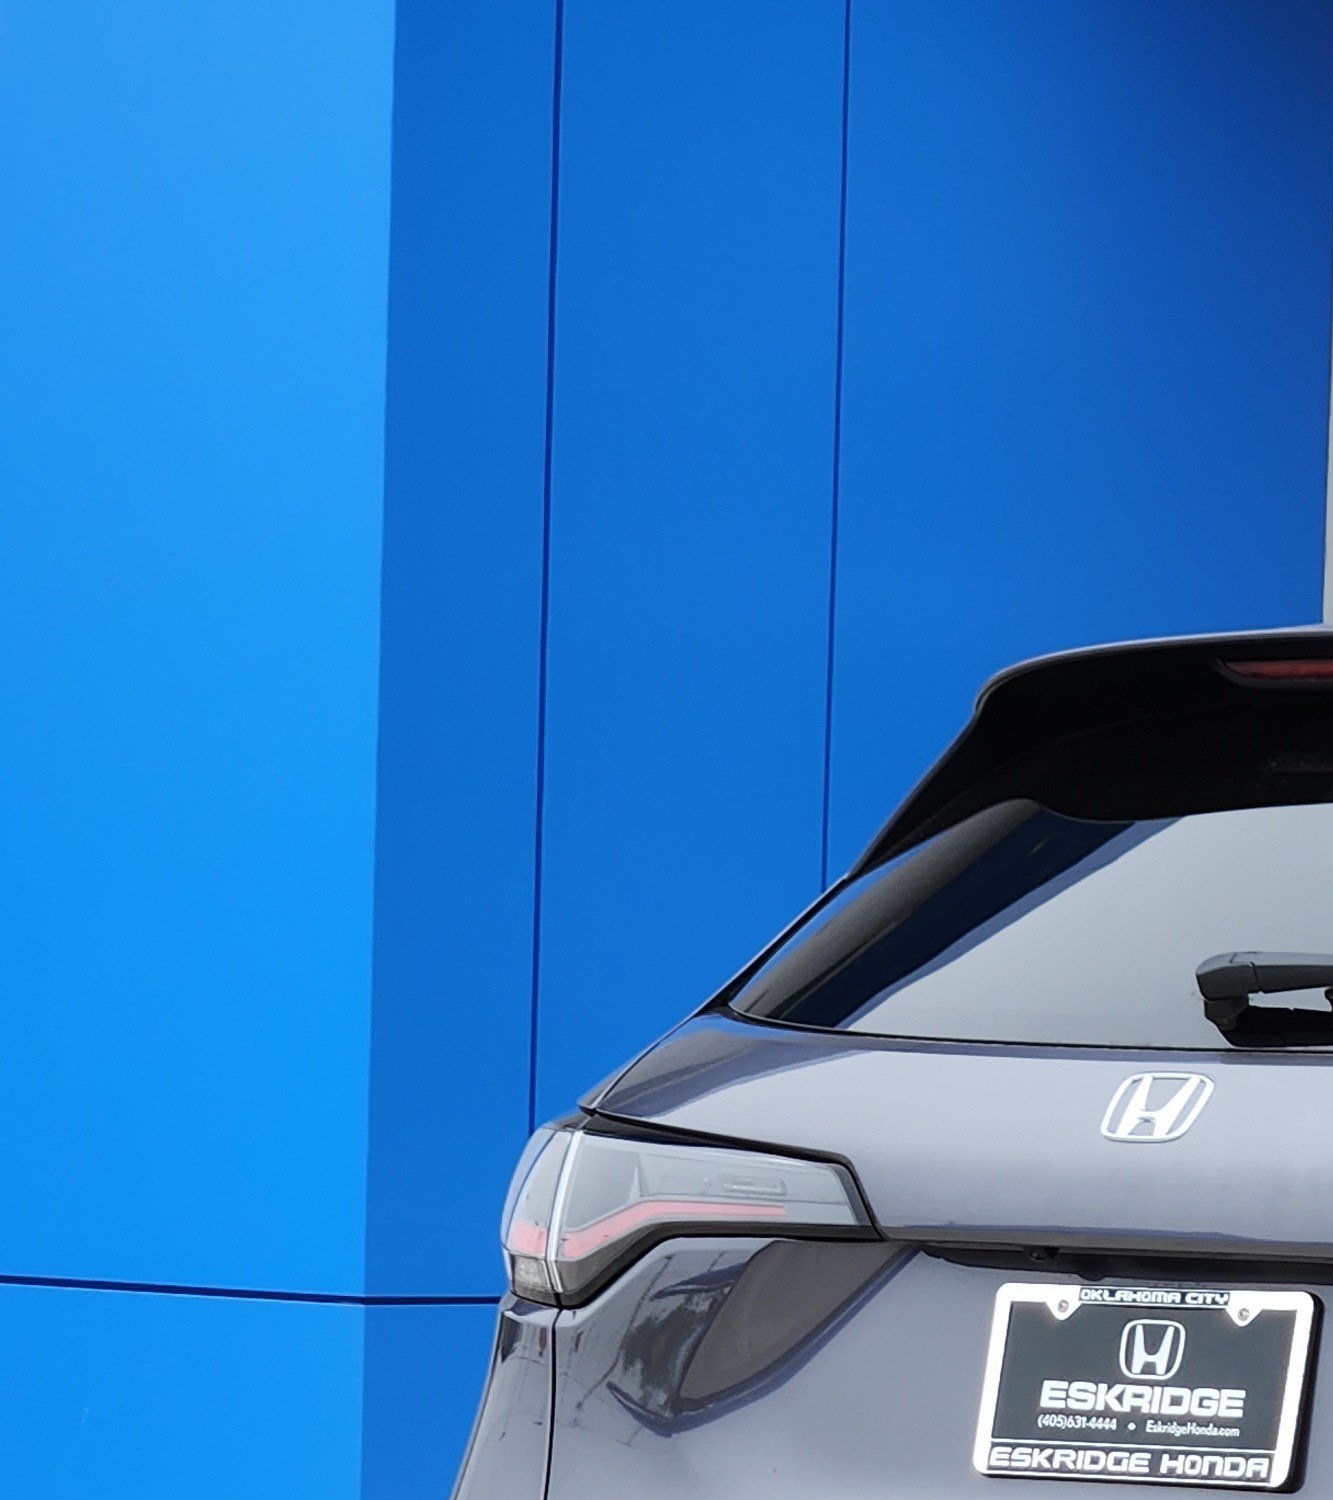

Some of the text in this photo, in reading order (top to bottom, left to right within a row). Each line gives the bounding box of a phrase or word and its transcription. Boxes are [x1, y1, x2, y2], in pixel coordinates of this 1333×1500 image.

[1080, 1288, 1230, 1306] OKLAHOMA CITY
[1039, 1380, 1247, 1418] ESKRIDGE
[1145, 1420, 1241, 1437] EskridgeHonda.com
[989, 1447, 1270, 1479] ESKRIDGE HONDA
